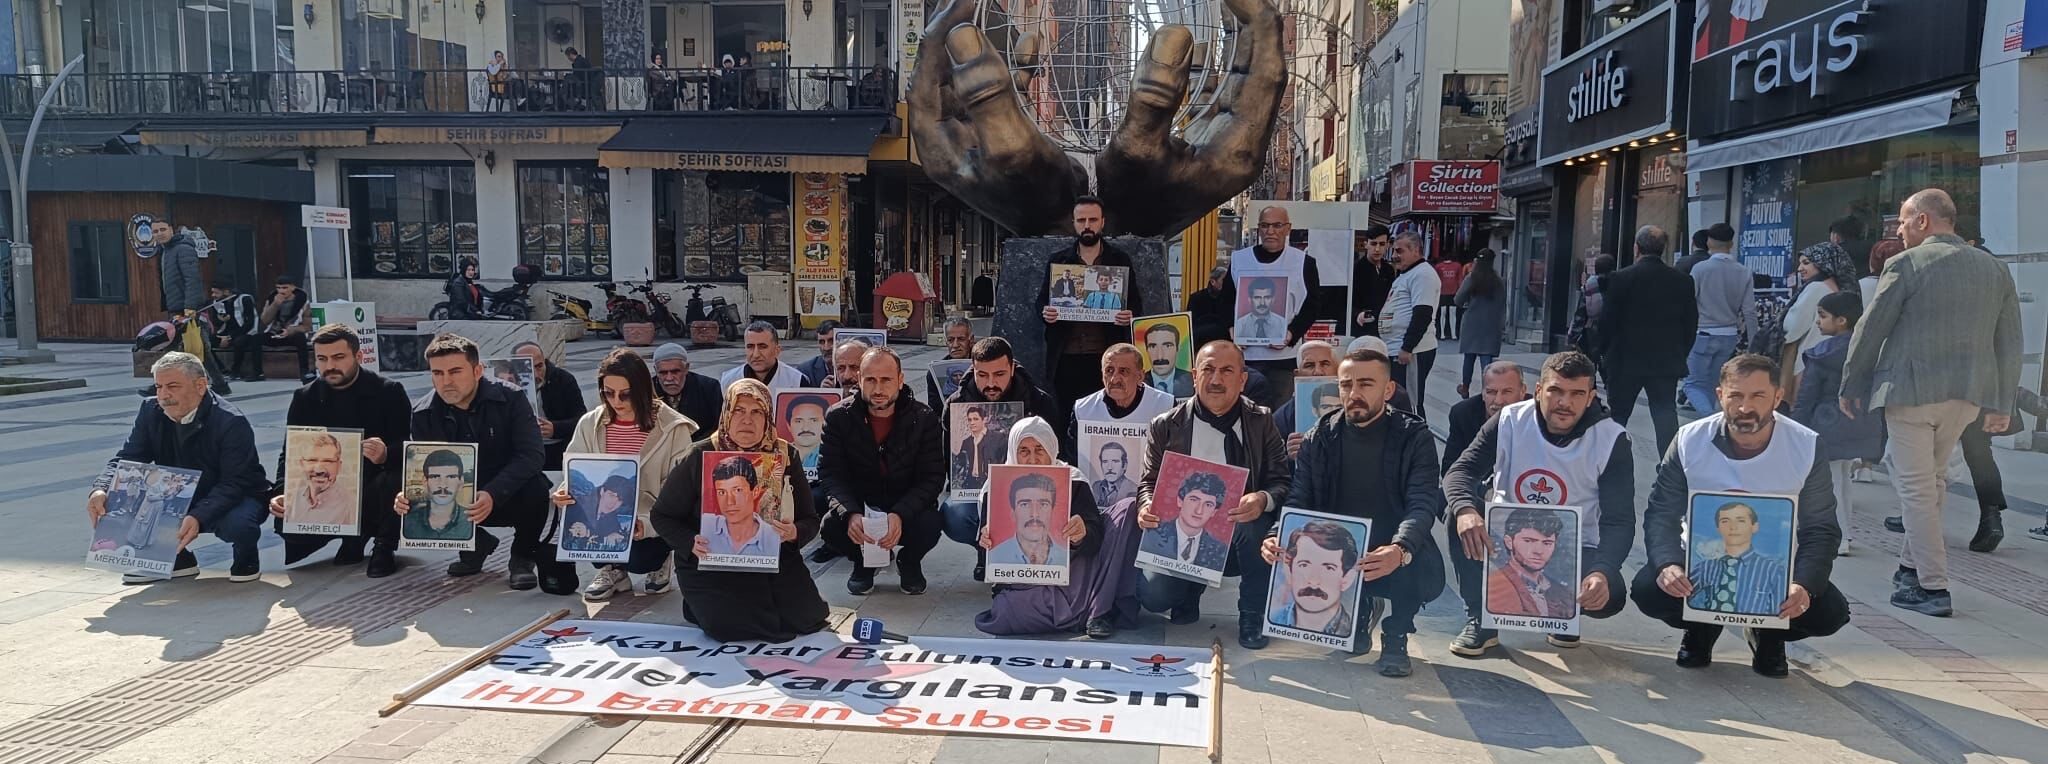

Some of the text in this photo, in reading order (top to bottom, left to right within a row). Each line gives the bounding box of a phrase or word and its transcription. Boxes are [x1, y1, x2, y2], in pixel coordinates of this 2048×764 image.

[1730, 12, 1858, 101] rays
[1568, 49, 1625, 123] stilife
[446, 129, 548, 141] ŞEHİR SOFRASI
[678, 154, 788, 169] ŞEHİR SOFRASI
[1429, 164, 1482, 182] Şirin
[1641, 156, 1672, 186] stilife
[1418, 182, 1492, 193] Collection
[1751, 198, 1783, 225] BÜYÜK
[1743, 228, 1790, 247] SEZON SONU
[1084, 424, 1147, 437] İBRAHİM ÇELİK
[297, 524, 341, 534] TAHİR ELÇİ
[438, 541, 471, 549] DEMİREL
[568, 551, 594, 559] İSMAİL
[746, 557, 777, 565] AKYILDIZ
[94, 554, 168, 572] MERYEM BULUT
[1175, 562, 1203, 575] KAVAK
[994, 567, 1061, 579] Eset GÖKTAYI
[1493, 616, 1569, 631] Yılmaz GÜMÜŞ
[1714, 615, 1748, 624] AYDIN
[1268, 626, 1300, 639] Medeni
[594, 634, 1112, 672] Kayıplar Bulunsun
[488, 654, 1199, 708] Failler Yargılansın
[461, 679, 1115, 733] İHD Batman Şubesi
